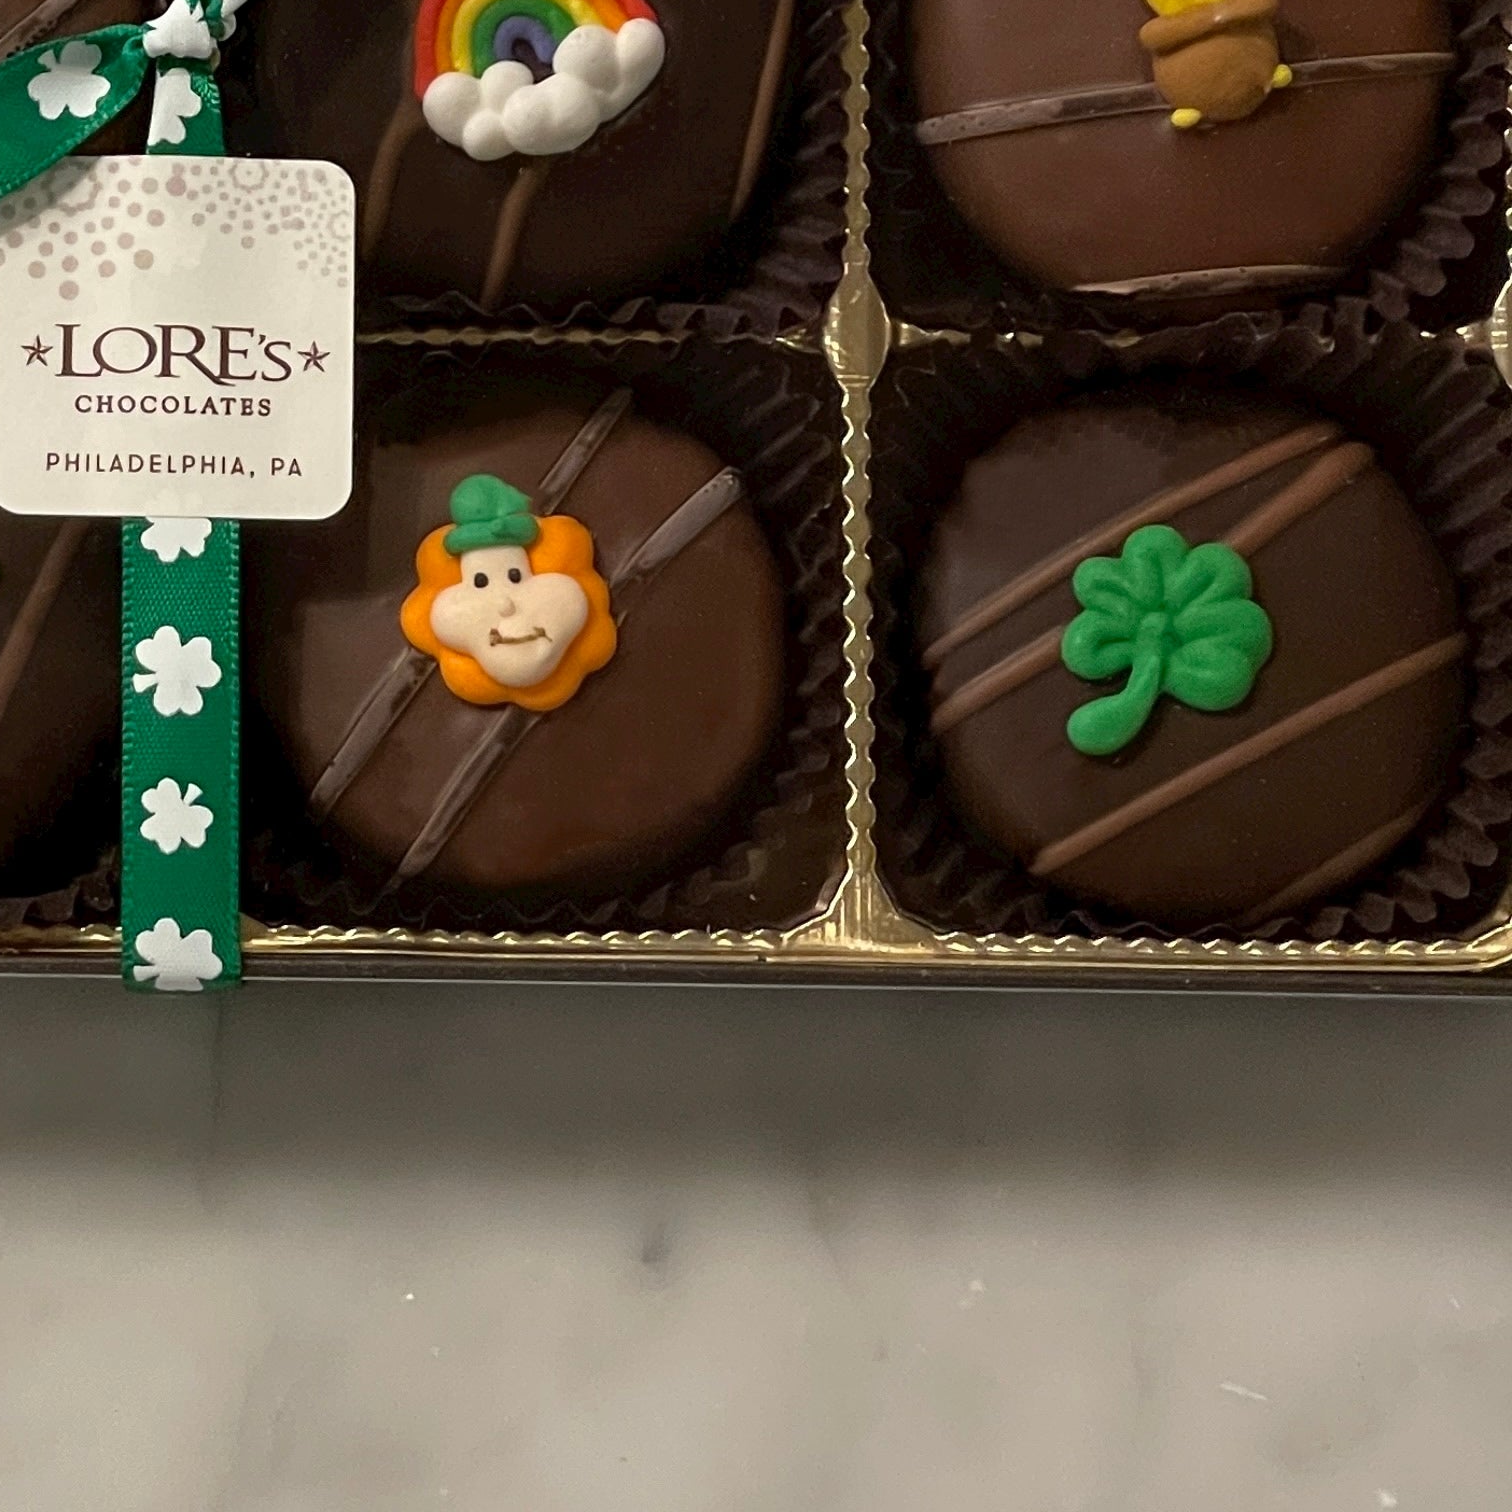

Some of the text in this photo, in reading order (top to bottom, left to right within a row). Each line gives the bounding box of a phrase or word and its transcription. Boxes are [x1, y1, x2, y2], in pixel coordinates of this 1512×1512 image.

[74, 394, 272, 417] CHOCOLATES
[45, 452, 303, 478] PHILADELPHIA, PA
